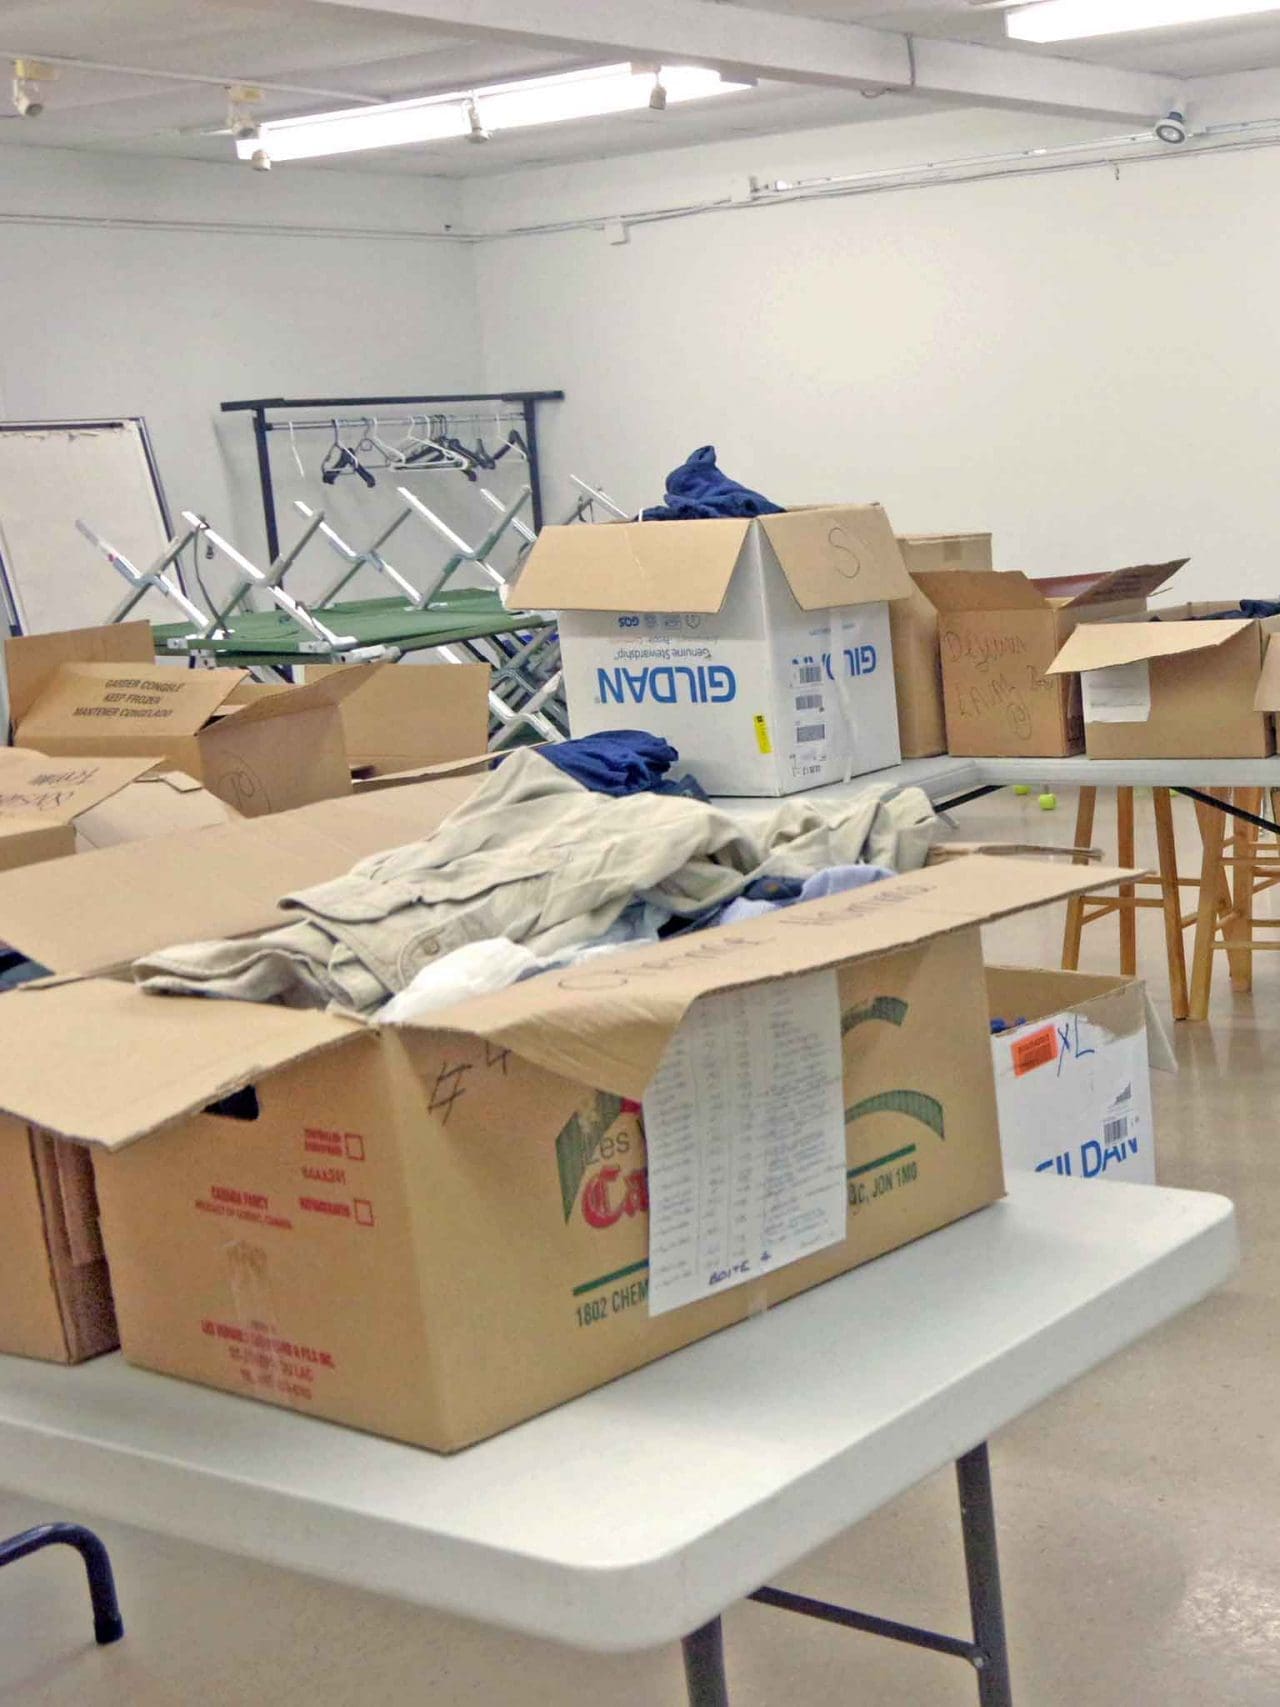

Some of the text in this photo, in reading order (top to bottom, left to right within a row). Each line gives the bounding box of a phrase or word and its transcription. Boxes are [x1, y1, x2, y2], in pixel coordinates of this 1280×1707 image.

[826, 526, 863, 579] S
[596, 665, 737, 704] GILDAN
[792, 645, 877, 680] GIL
[1056, 1013, 1096, 1077] XL
[581, 1166, 650, 1230] Ca
[576, 1297, 608, 1328] 1802
